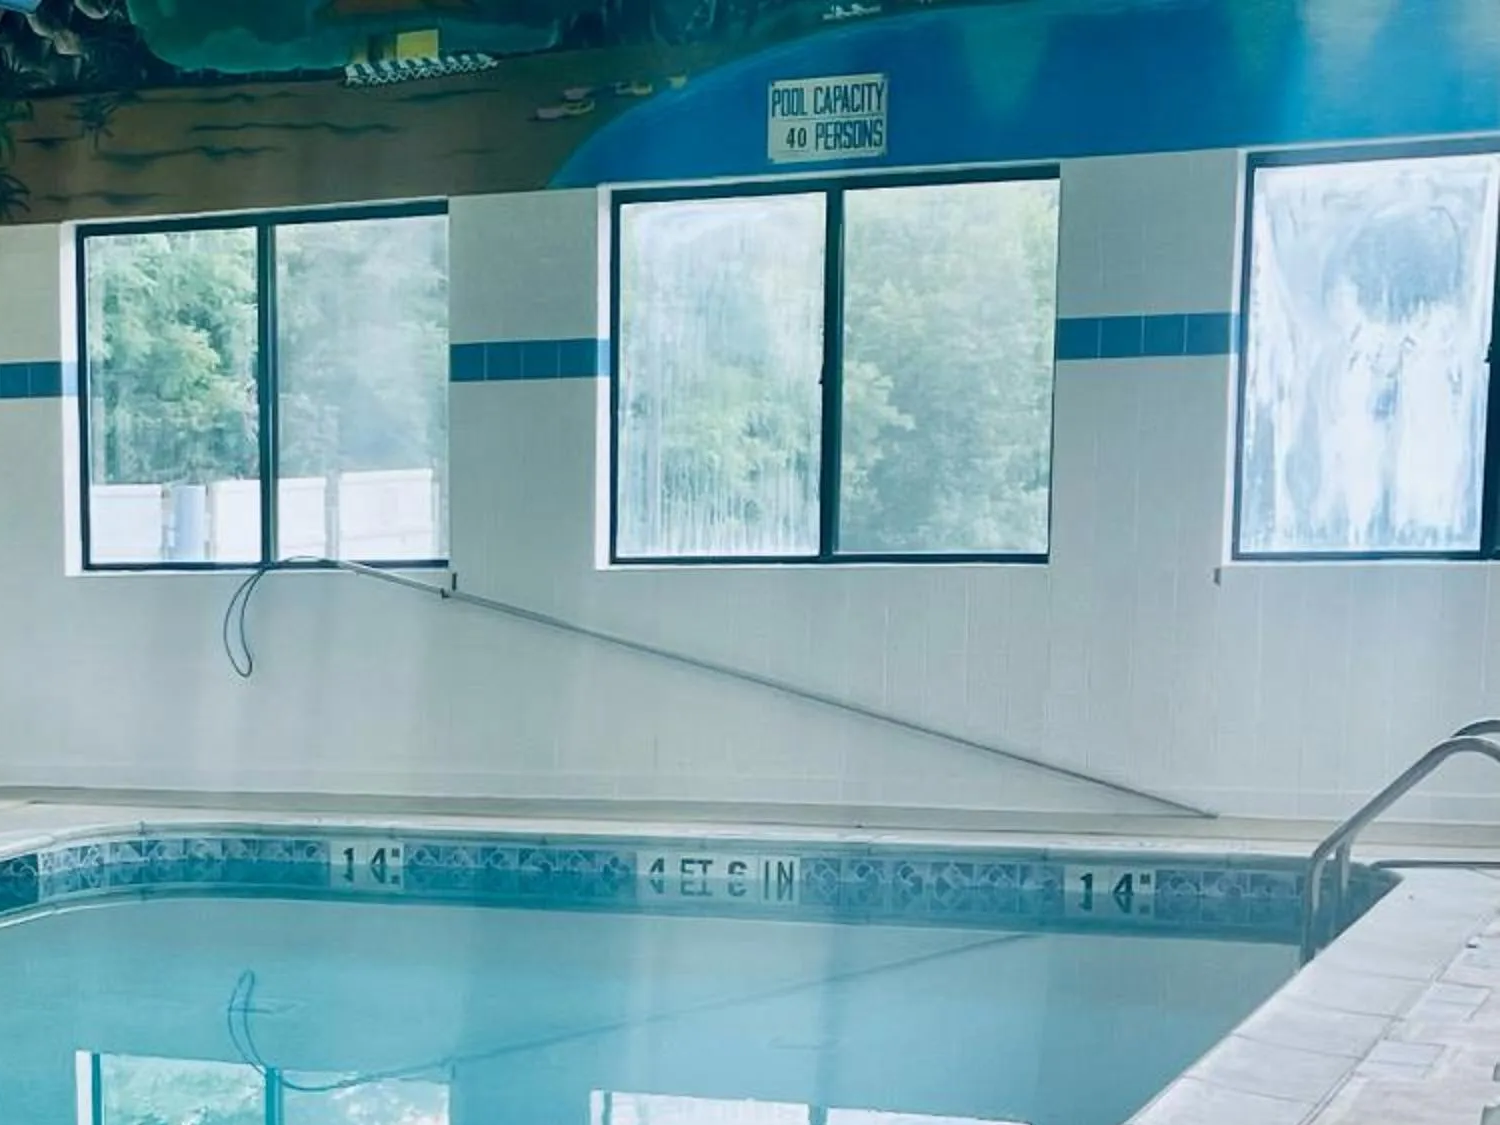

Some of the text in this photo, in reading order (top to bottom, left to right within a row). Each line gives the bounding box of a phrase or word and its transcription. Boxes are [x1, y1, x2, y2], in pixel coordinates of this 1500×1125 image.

[771, 81, 885, 117] POOL CAPACITY
[785, 118, 884, 152] 40 PERSONS
